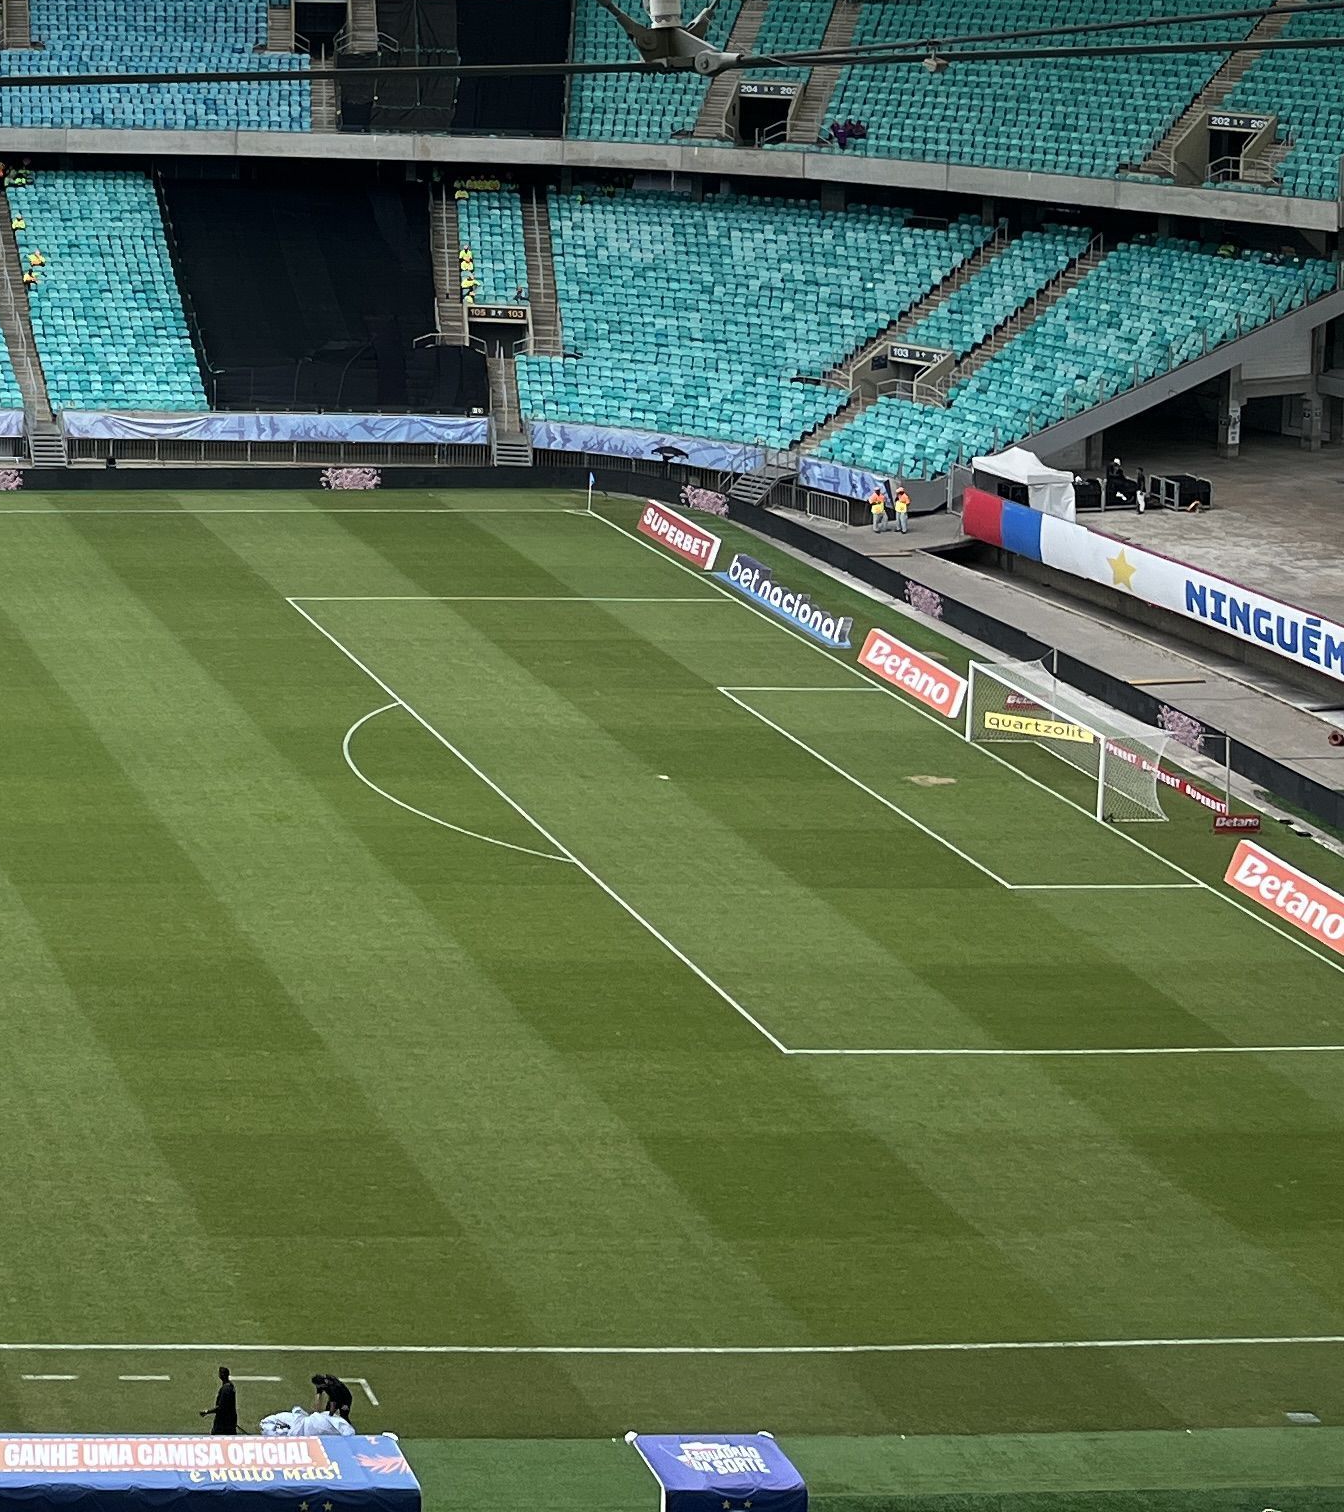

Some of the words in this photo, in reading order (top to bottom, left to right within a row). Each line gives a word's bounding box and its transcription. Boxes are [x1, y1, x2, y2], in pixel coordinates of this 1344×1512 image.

[740, 85, 758, 93] 204
[1211, 117, 1230, 126] 202
[506, 309, 524, 318] 103
[893, 348, 910, 358] 103
[643, 507, 710, 559] SUPERBET
[1185, 579, 1344, 676] NINGUÉM
[865, 639, 949, 705] Betano
[989, 716, 1084, 739] quartzolit
[1186, 784, 1226, 813] SUPERBET
[1215, 817, 1259, 827] Betano
[1234, 853, 1344, 940] Betano
[5, 1442, 79, 1467] GANHE
[82, 1441, 132, 1466] UMA
[138, 1439, 223, 1466] CAMISA
[227, 1439, 312, 1465] OFICIAL
[685, 1446, 761, 1461] ESQUADRÃO
[712, 1460, 772, 1475] SORTE
